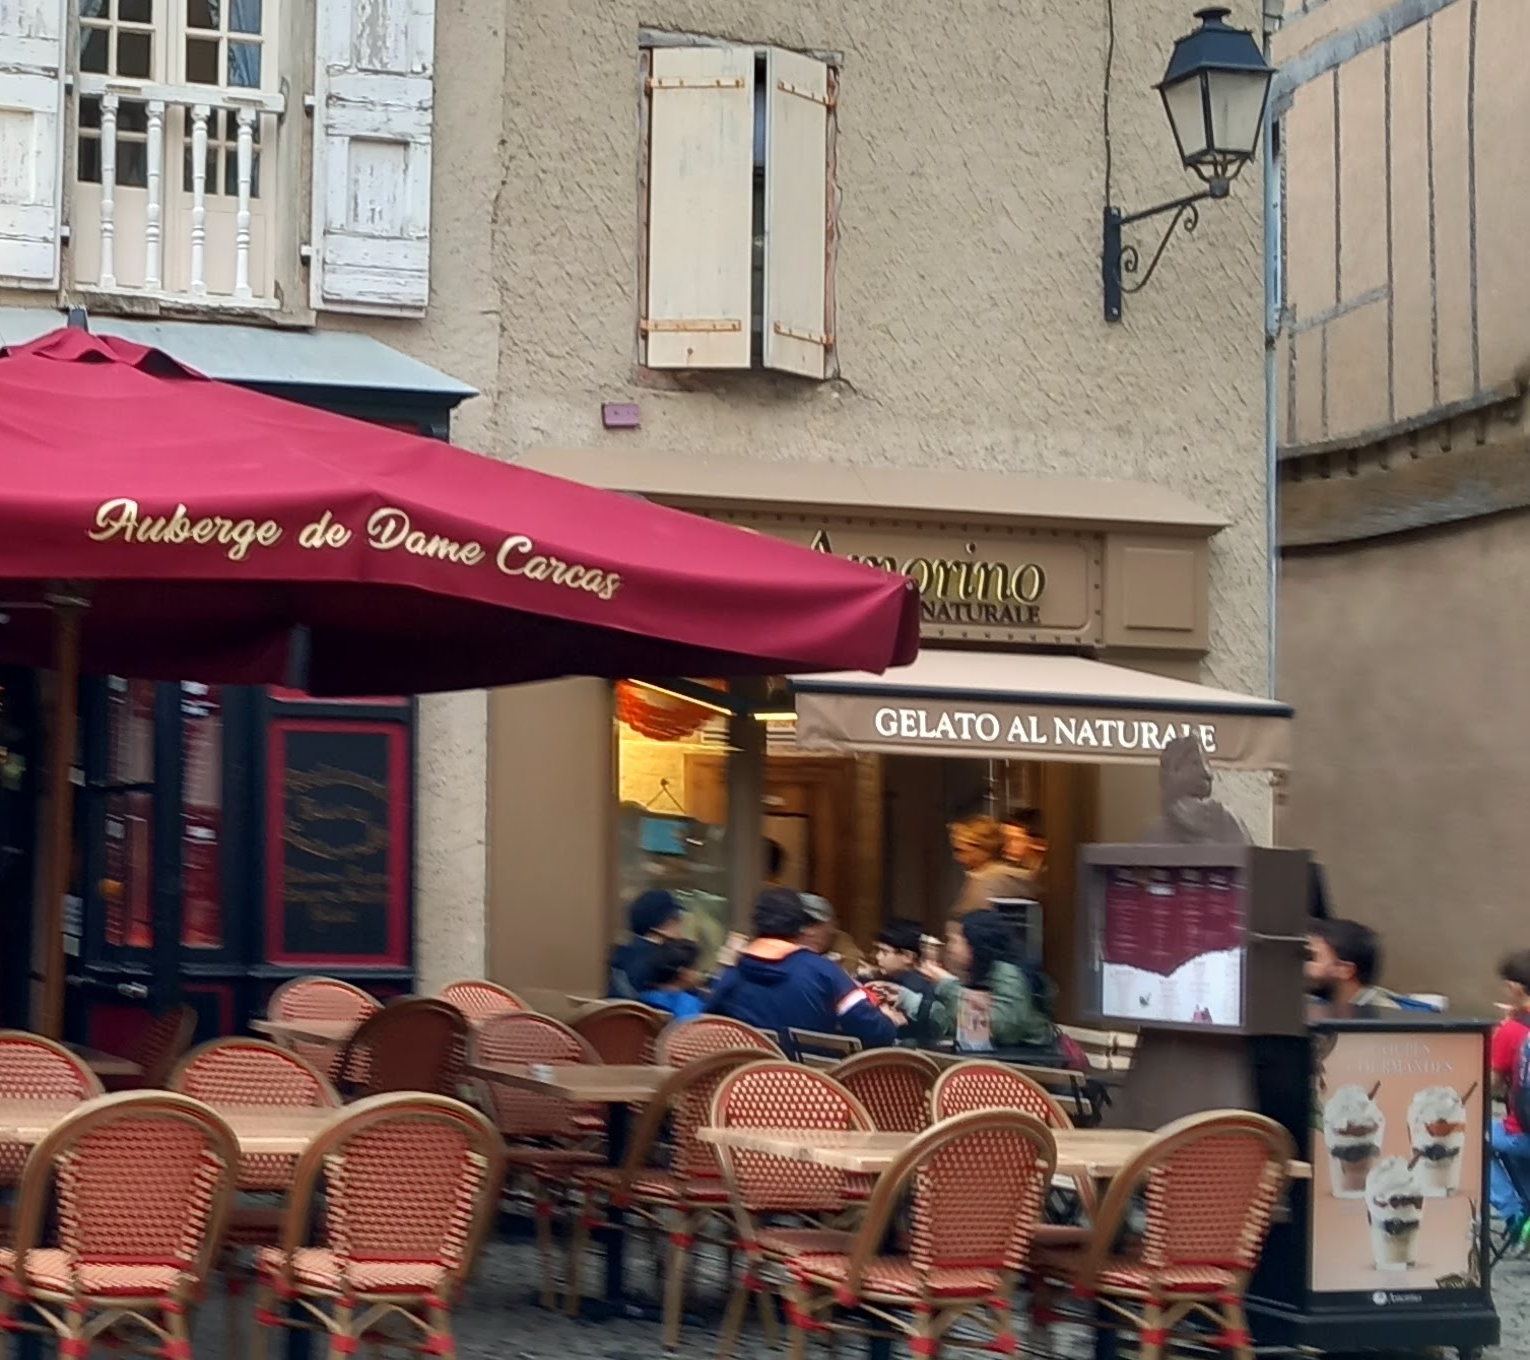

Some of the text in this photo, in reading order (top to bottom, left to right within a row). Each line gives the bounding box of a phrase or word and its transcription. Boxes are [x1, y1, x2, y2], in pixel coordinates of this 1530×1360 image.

[86, 497, 622, 600] Auberge de Dame Carcas
[920, 601, 1041, 624] NATURALE
[875, 707, 1000, 742] GELATO
[1007, 716, 1047, 745] AL
